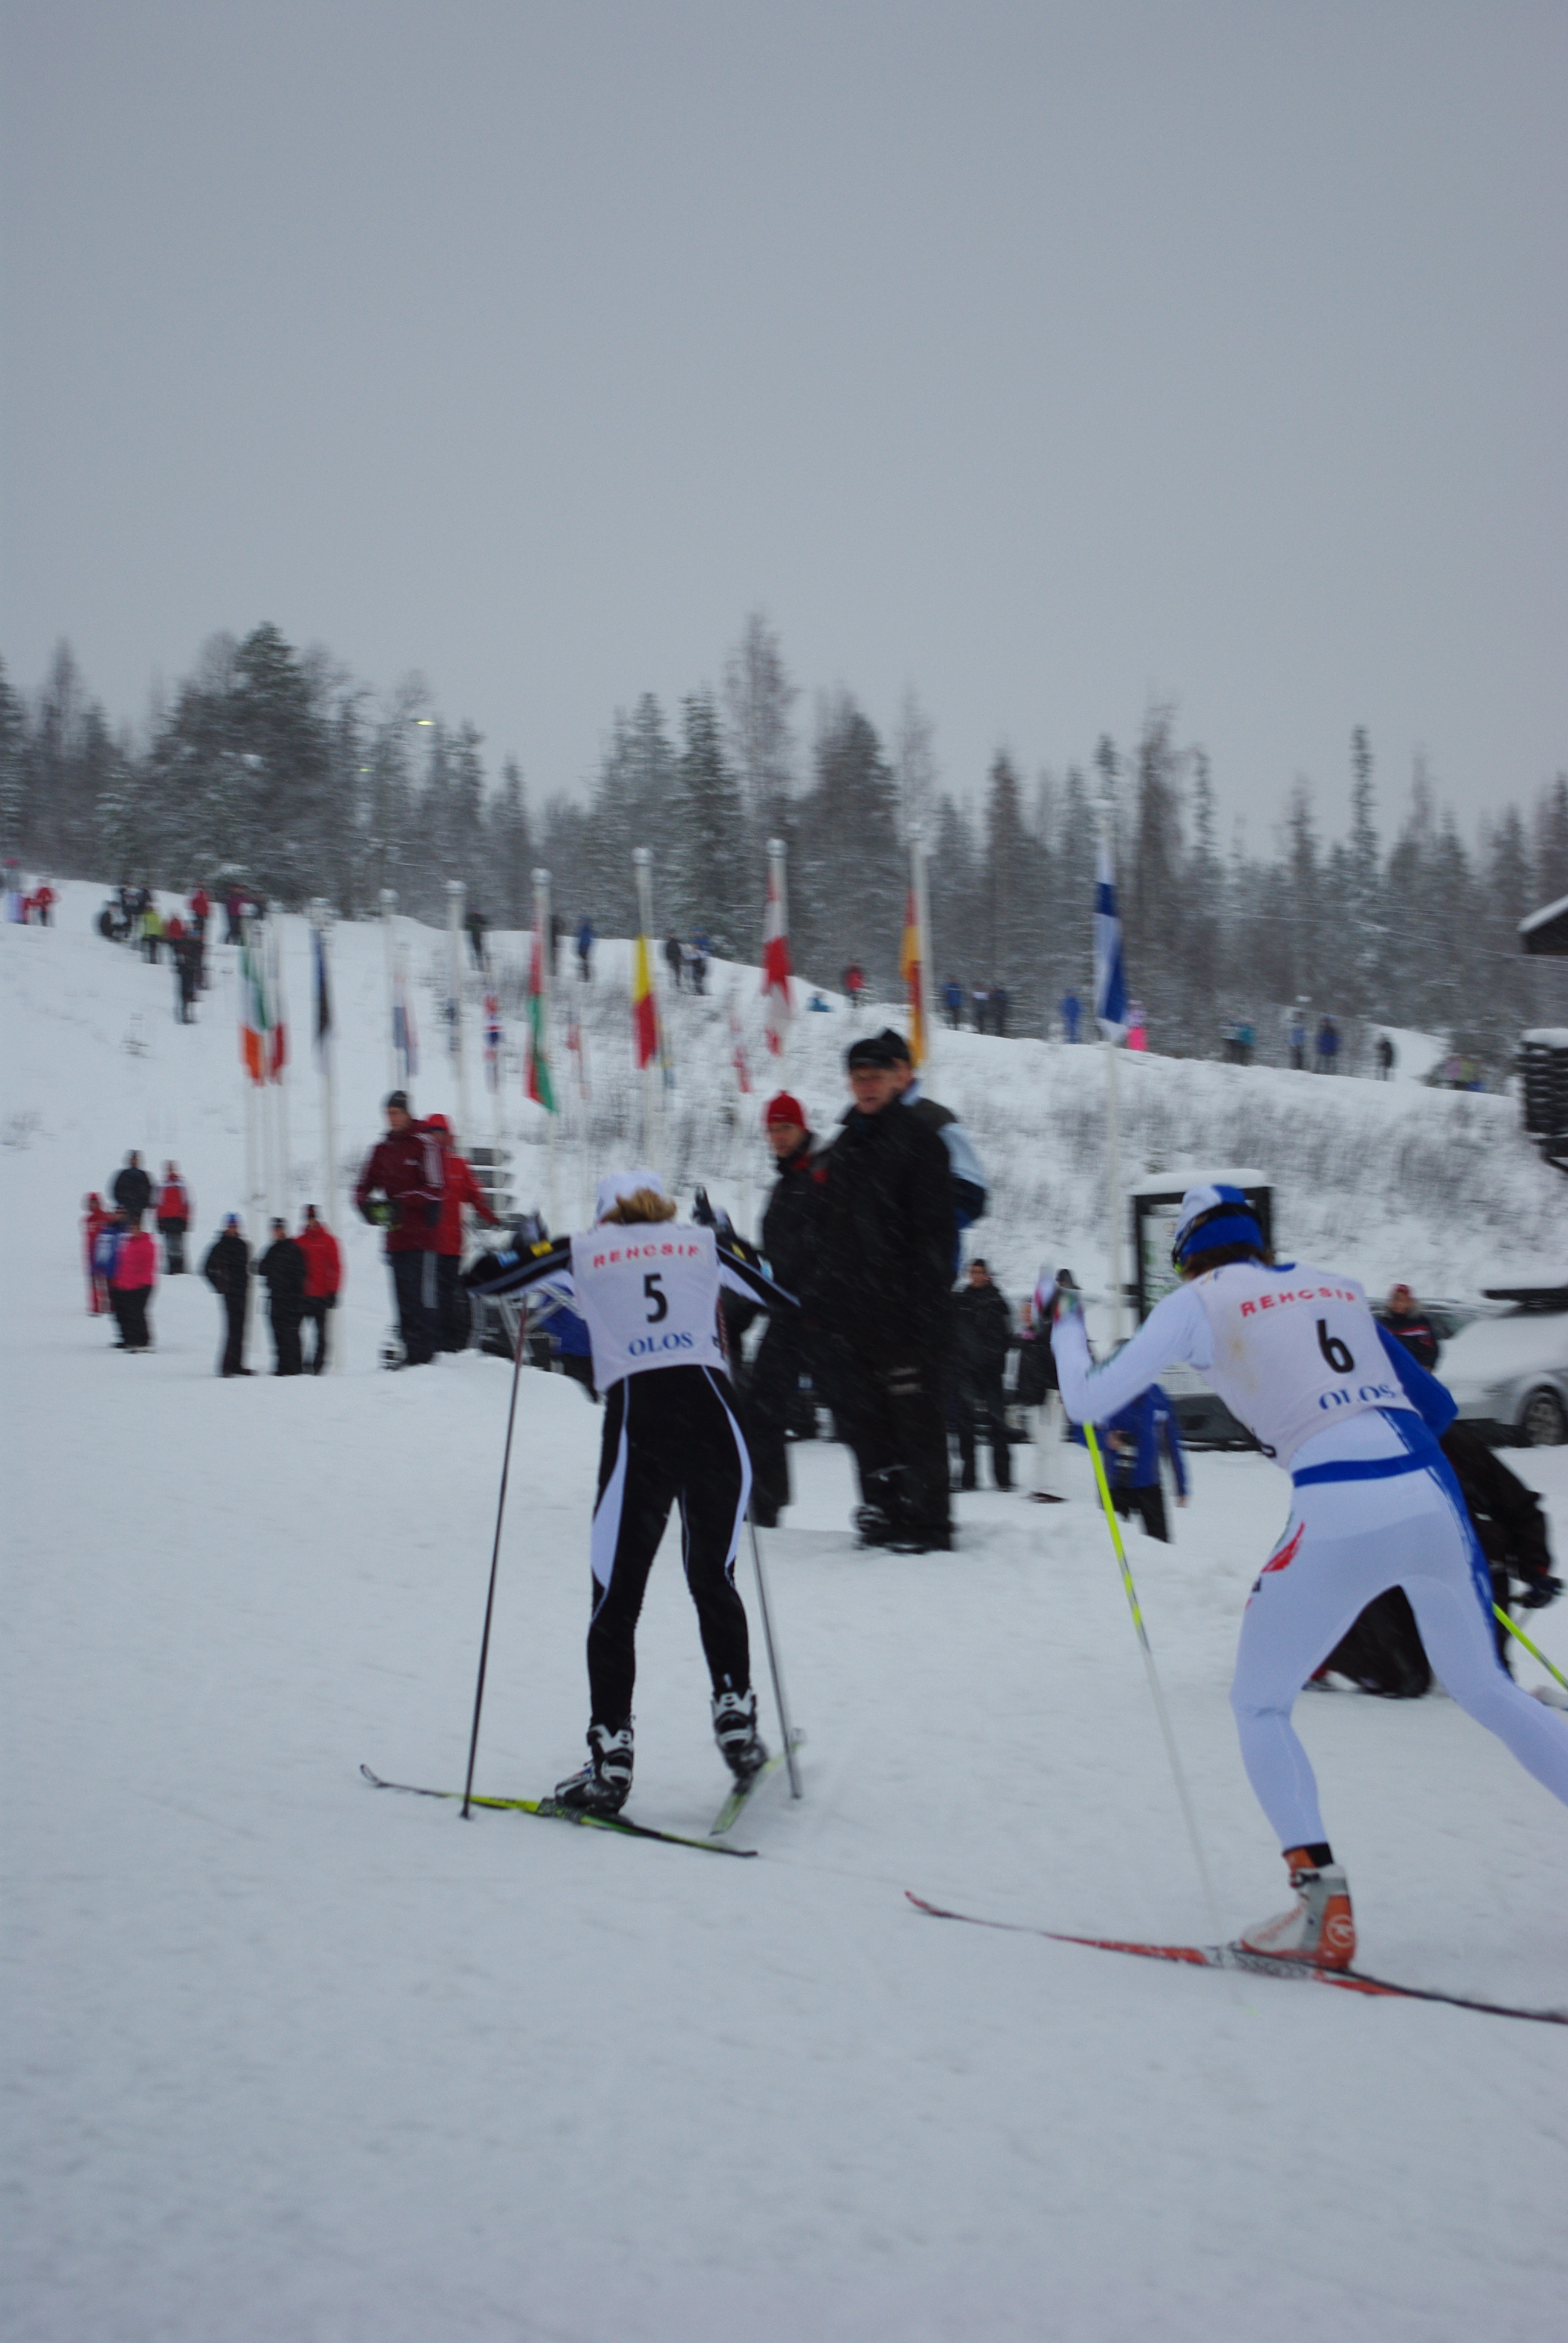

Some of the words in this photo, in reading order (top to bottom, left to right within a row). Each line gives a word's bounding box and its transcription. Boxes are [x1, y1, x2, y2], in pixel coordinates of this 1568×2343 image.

[644, 1273, 668, 1323] 5
[628, 1332, 693, 1356] OLOS
[1316, 1318, 1355, 1374] 6
